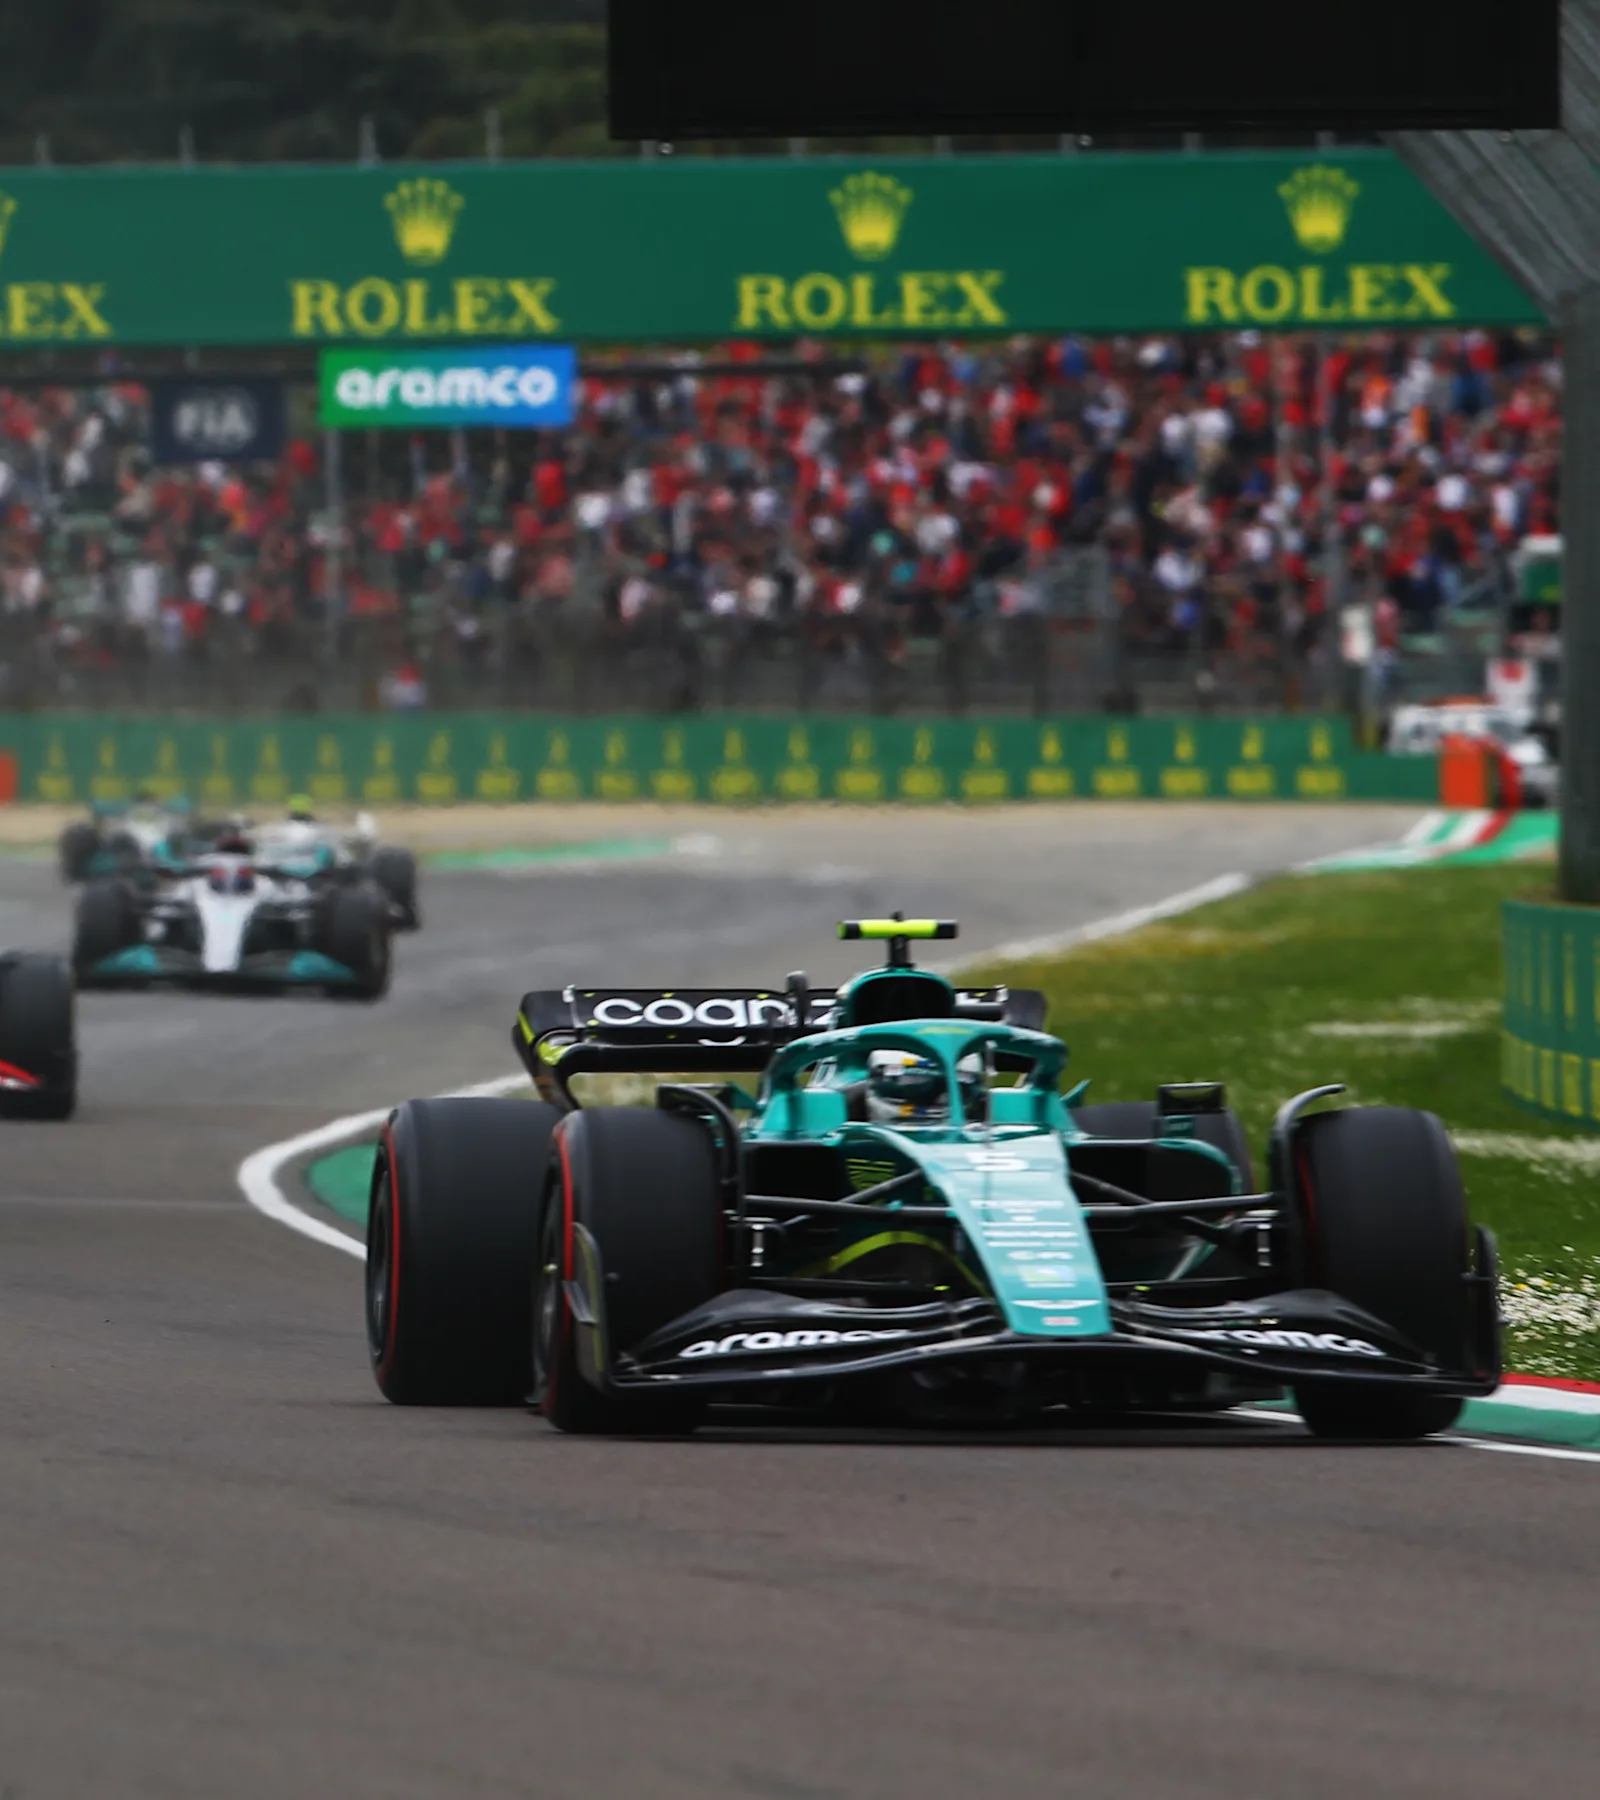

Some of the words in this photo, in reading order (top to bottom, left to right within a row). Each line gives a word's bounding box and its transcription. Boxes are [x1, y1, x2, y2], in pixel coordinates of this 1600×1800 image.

[286, 278, 558, 337] ROLEX
[735, 271, 1007, 329] ROLEX
[1184, 264, 1456, 322] ROLEX
[335, 367, 559, 409] aramco
[678, 1328, 911, 1358] aramco
